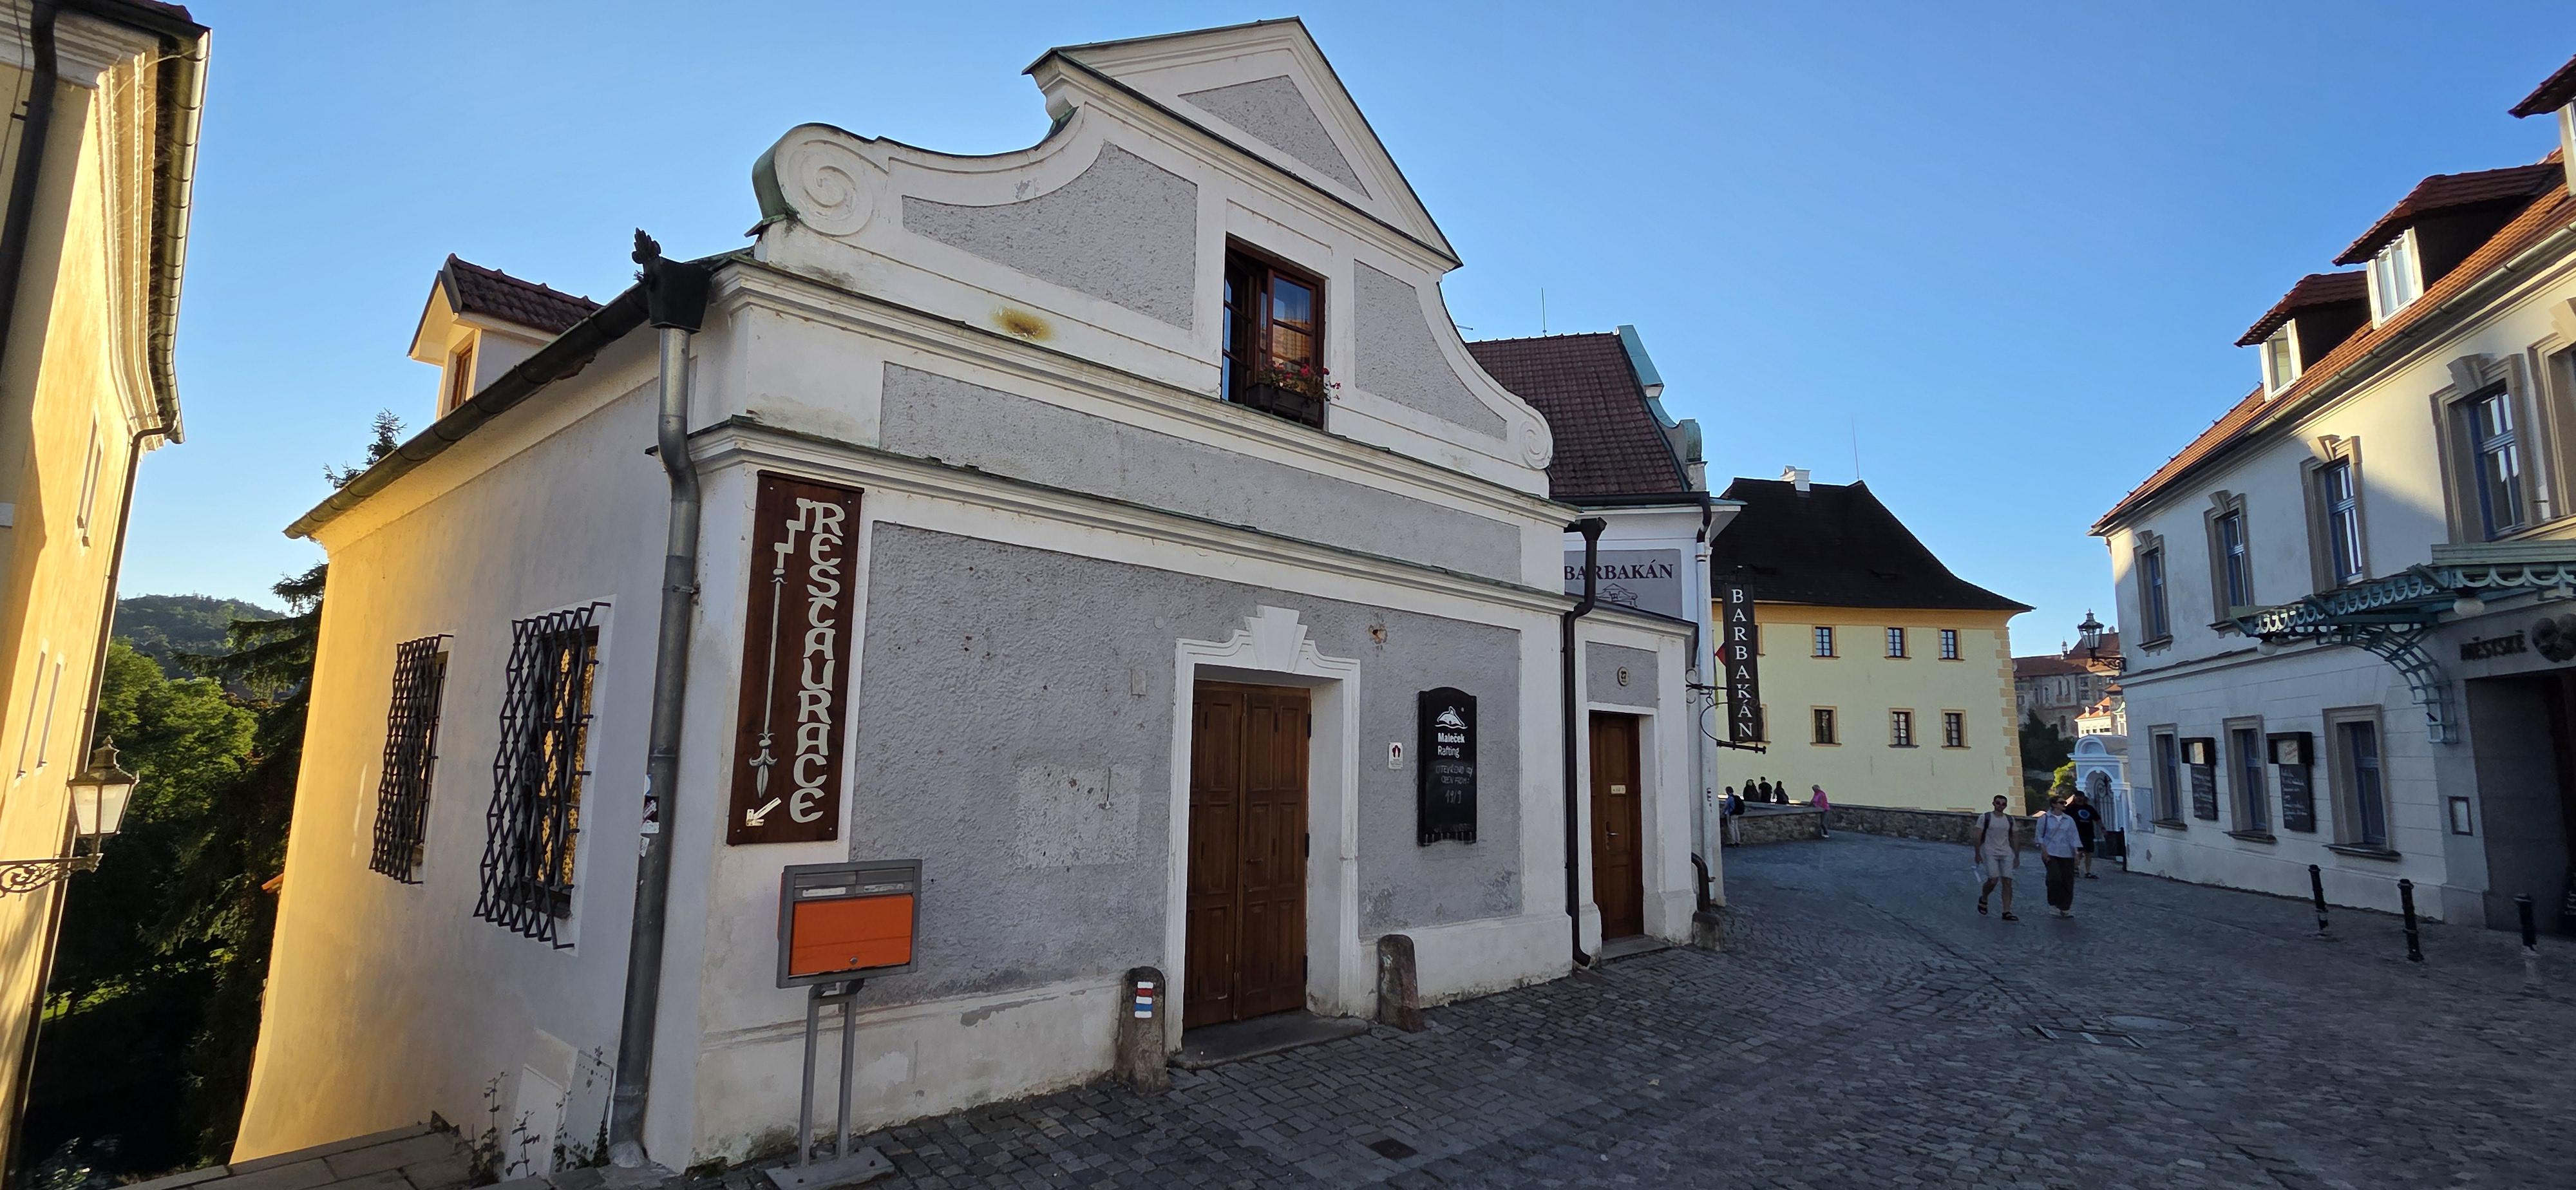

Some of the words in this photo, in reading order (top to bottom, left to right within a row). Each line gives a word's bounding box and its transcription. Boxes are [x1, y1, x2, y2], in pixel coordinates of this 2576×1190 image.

[1731, 589, 1753, 737] BARBAKÁN
[1437, 732, 1465, 743] Maleček
[1437, 745, 1460, 759] Rafting
